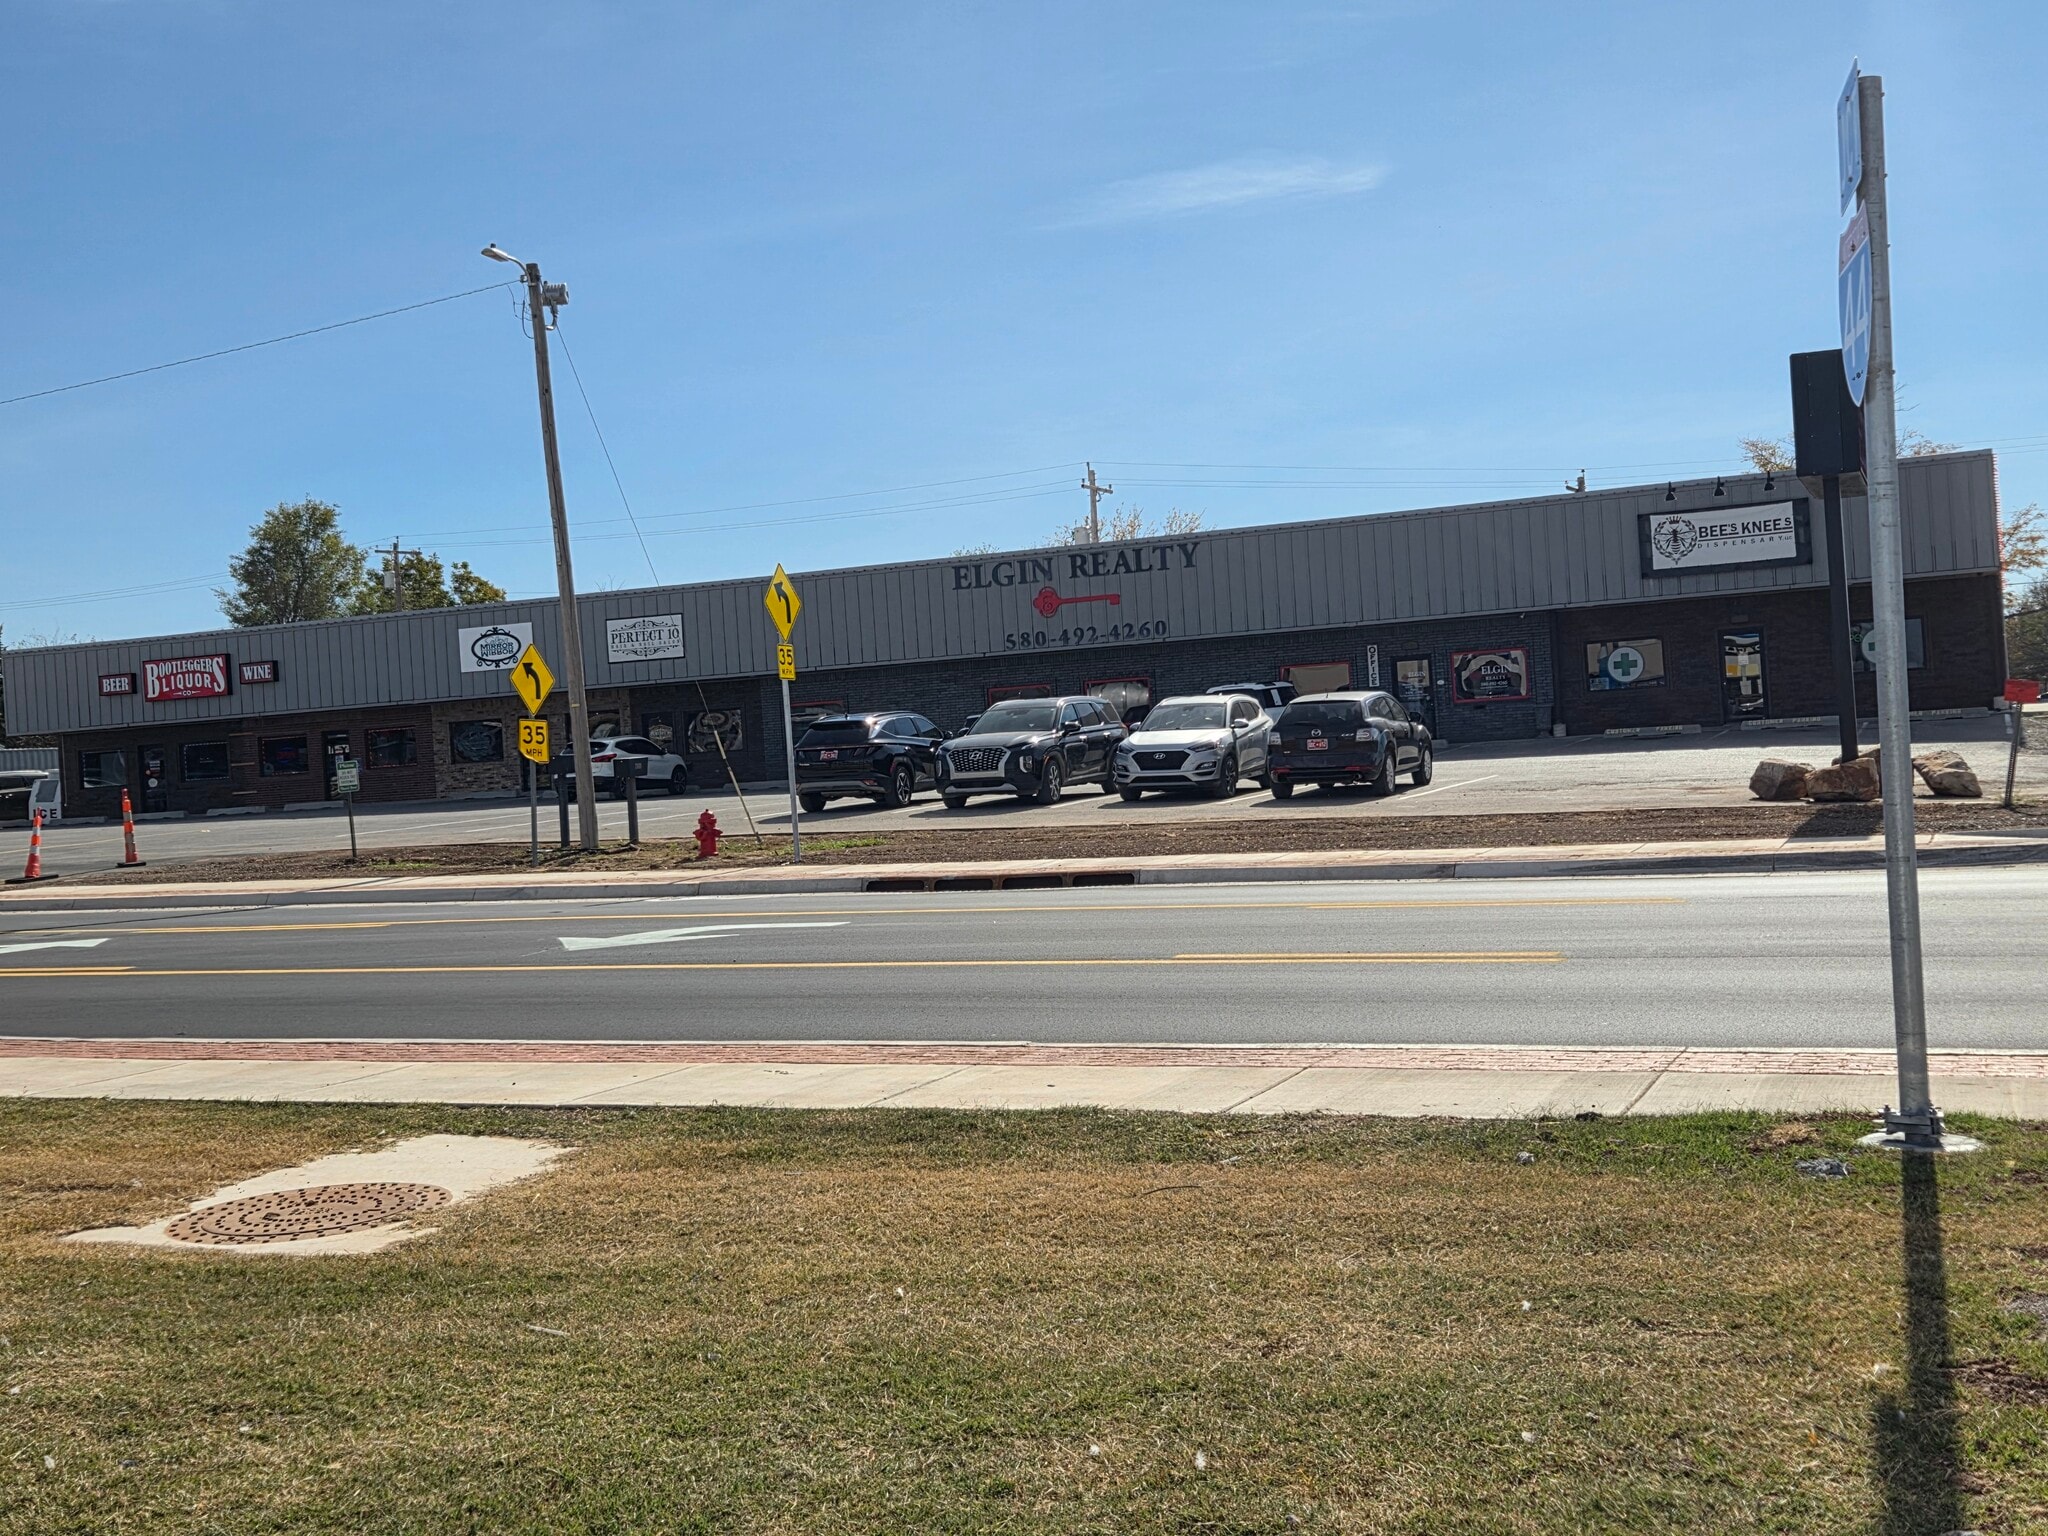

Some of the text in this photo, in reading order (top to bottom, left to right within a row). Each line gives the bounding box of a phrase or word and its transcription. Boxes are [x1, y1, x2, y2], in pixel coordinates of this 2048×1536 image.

[1844, 254, 1869, 367] 44
[1698, 517, 1792, 538] BEE'S KNEES
[952, 542, 1200, 590] ELGIN REALTY
[611, 627, 680, 644] PERFECT 10
[1005, 620, 1168, 650] 580-492-4260
[481, 642, 513, 650] MIRROR
[779, 649, 793, 665] 35
[1368, 646, 1378, 686] OFFICE
[145, 656, 225, 698] BOOTLEGGERS
[162, 672, 212, 692] LIQUOR
[243, 665, 272, 680] WINE
[103, 677, 129, 692] BEER
[523, 725, 545, 745] 35
[526, 748, 543, 758] MPH
[33, 808, 58, 819] ICE
